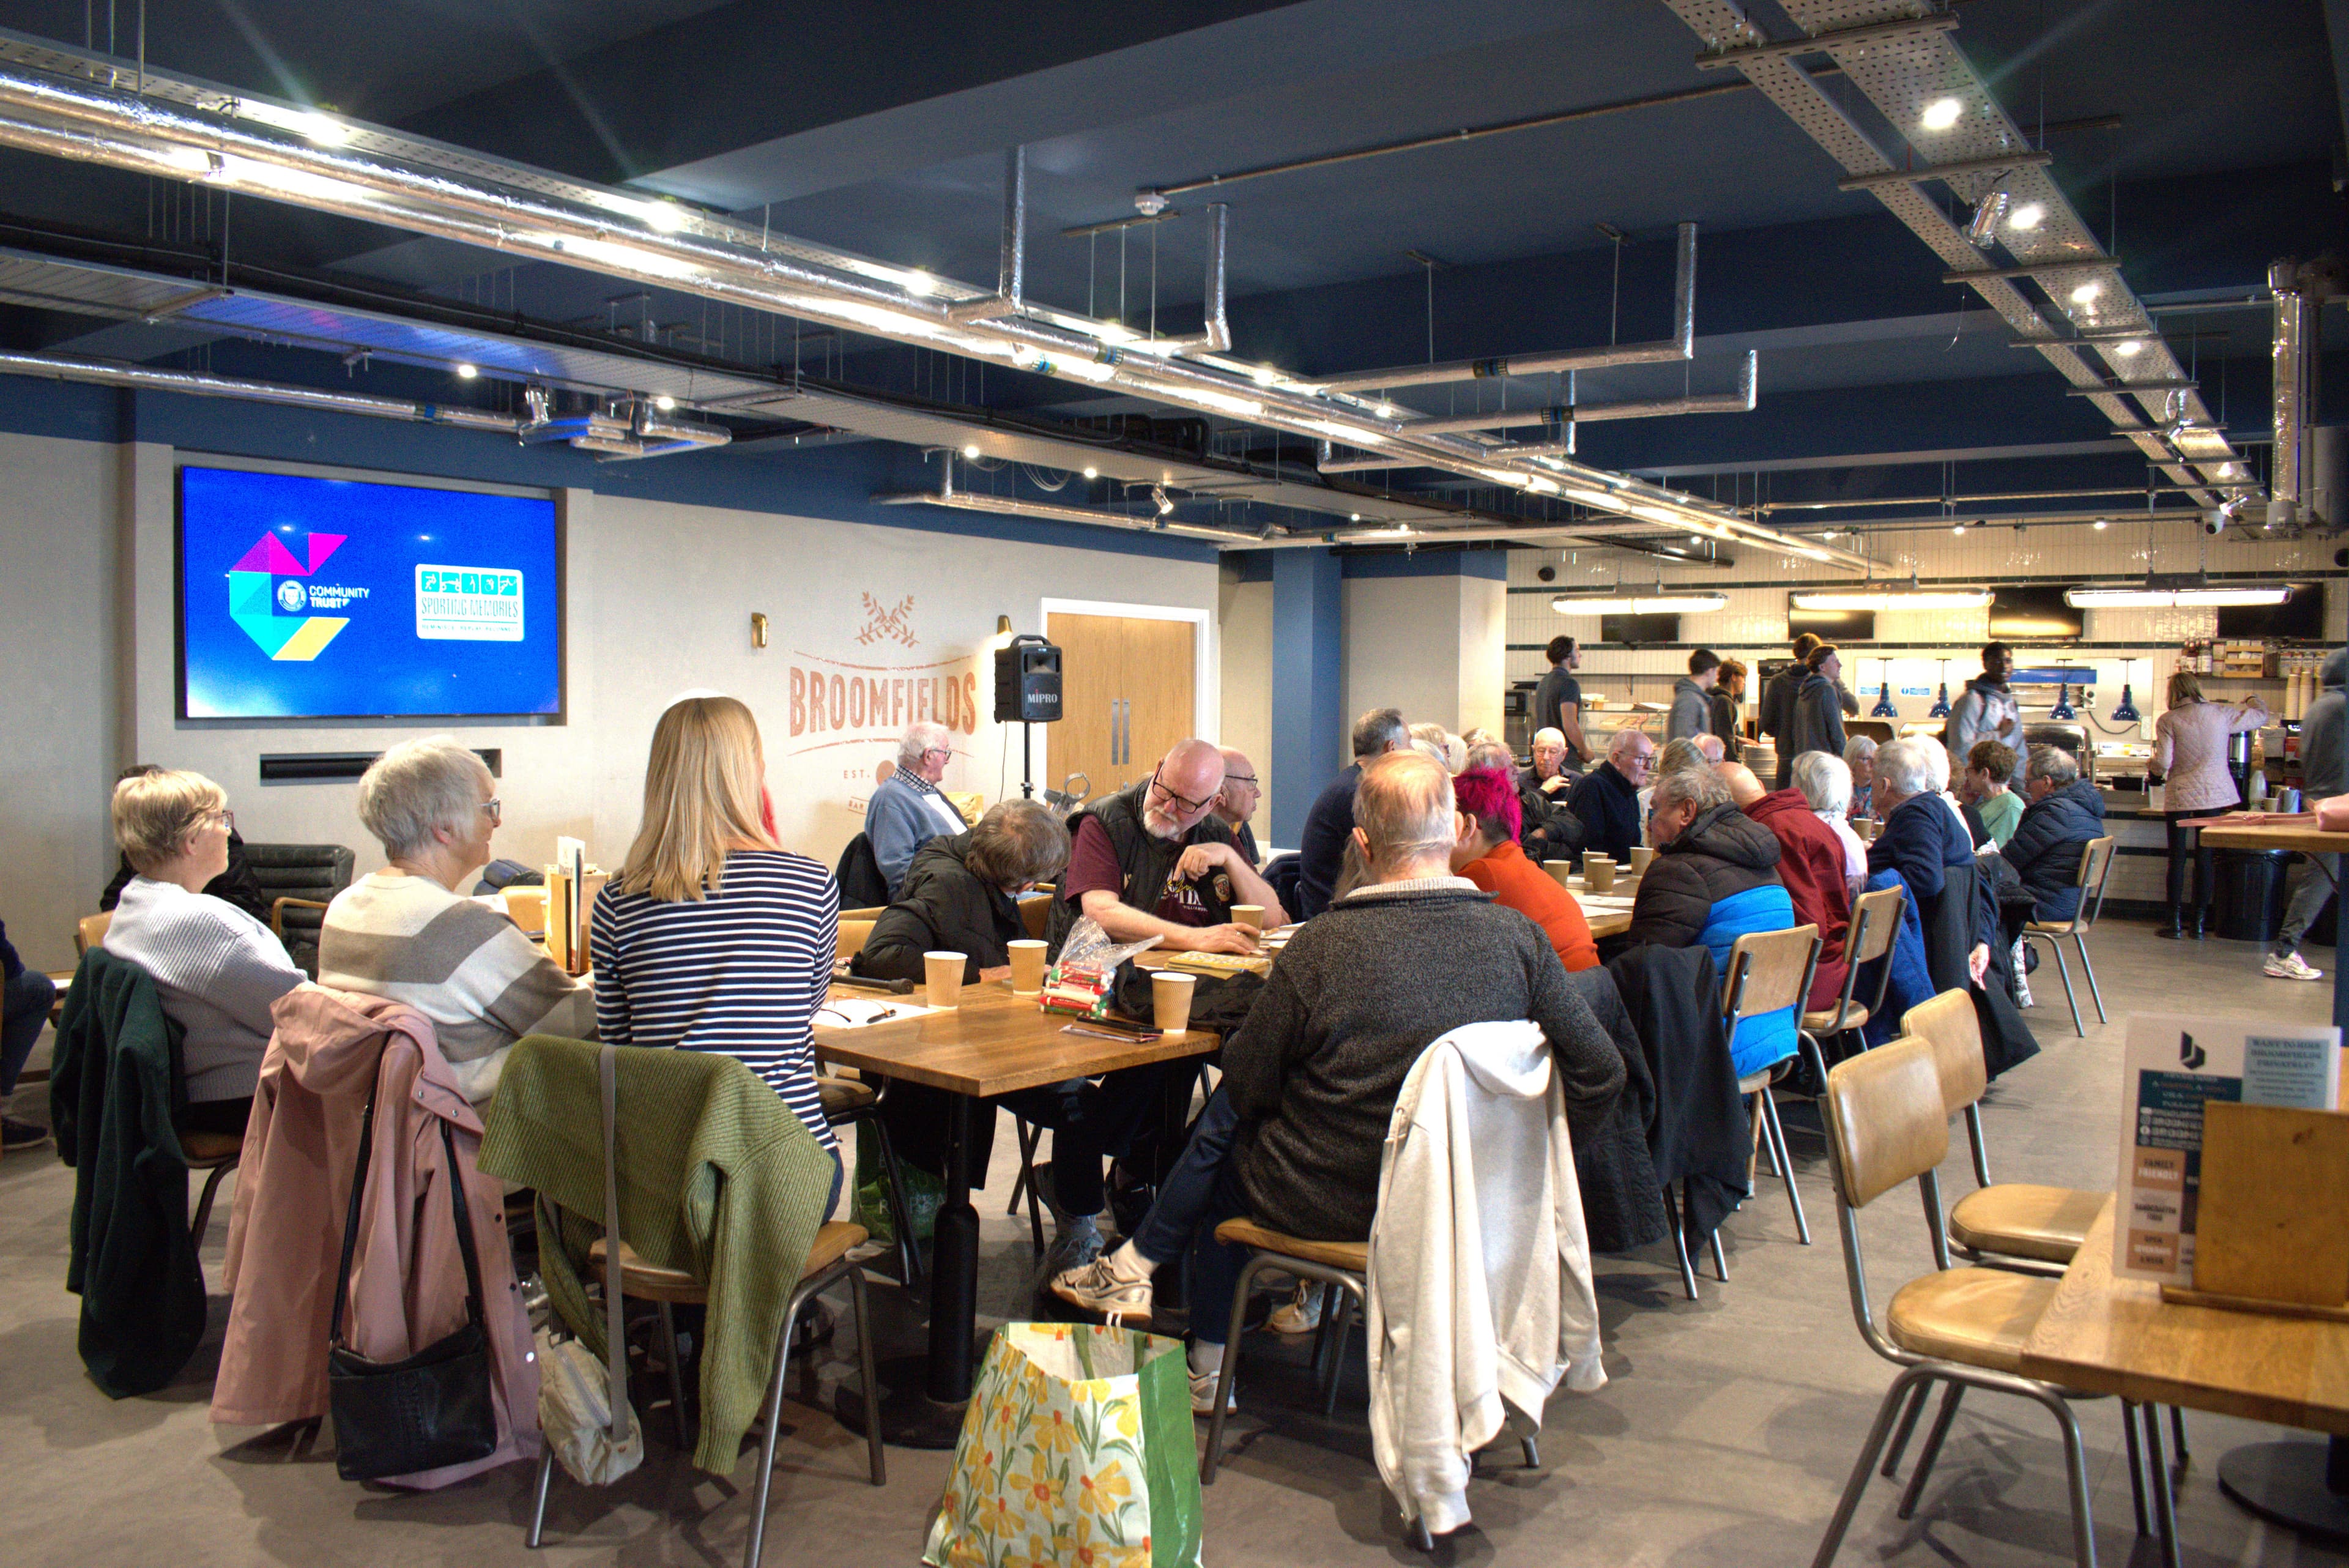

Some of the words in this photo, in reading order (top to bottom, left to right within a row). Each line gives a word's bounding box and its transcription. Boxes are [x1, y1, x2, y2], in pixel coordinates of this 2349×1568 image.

[309, 585, 370, 598] COMMUNITY
[310, 597, 343, 608] TRUST
[421, 597, 467, 615] SPORTING
[470, 600, 518, 617] MEMORIES
[790, 666, 976, 737] BROOMFIELDS
[1028, 689, 1058, 704] MIPRO
[843, 769, 870, 779] EST.
[848, 800, 864, 810] BAR
[2143, 1158, 2174, 1169] FAMILY
[2138, 1167, 2178, 1180] FRIENDLY
